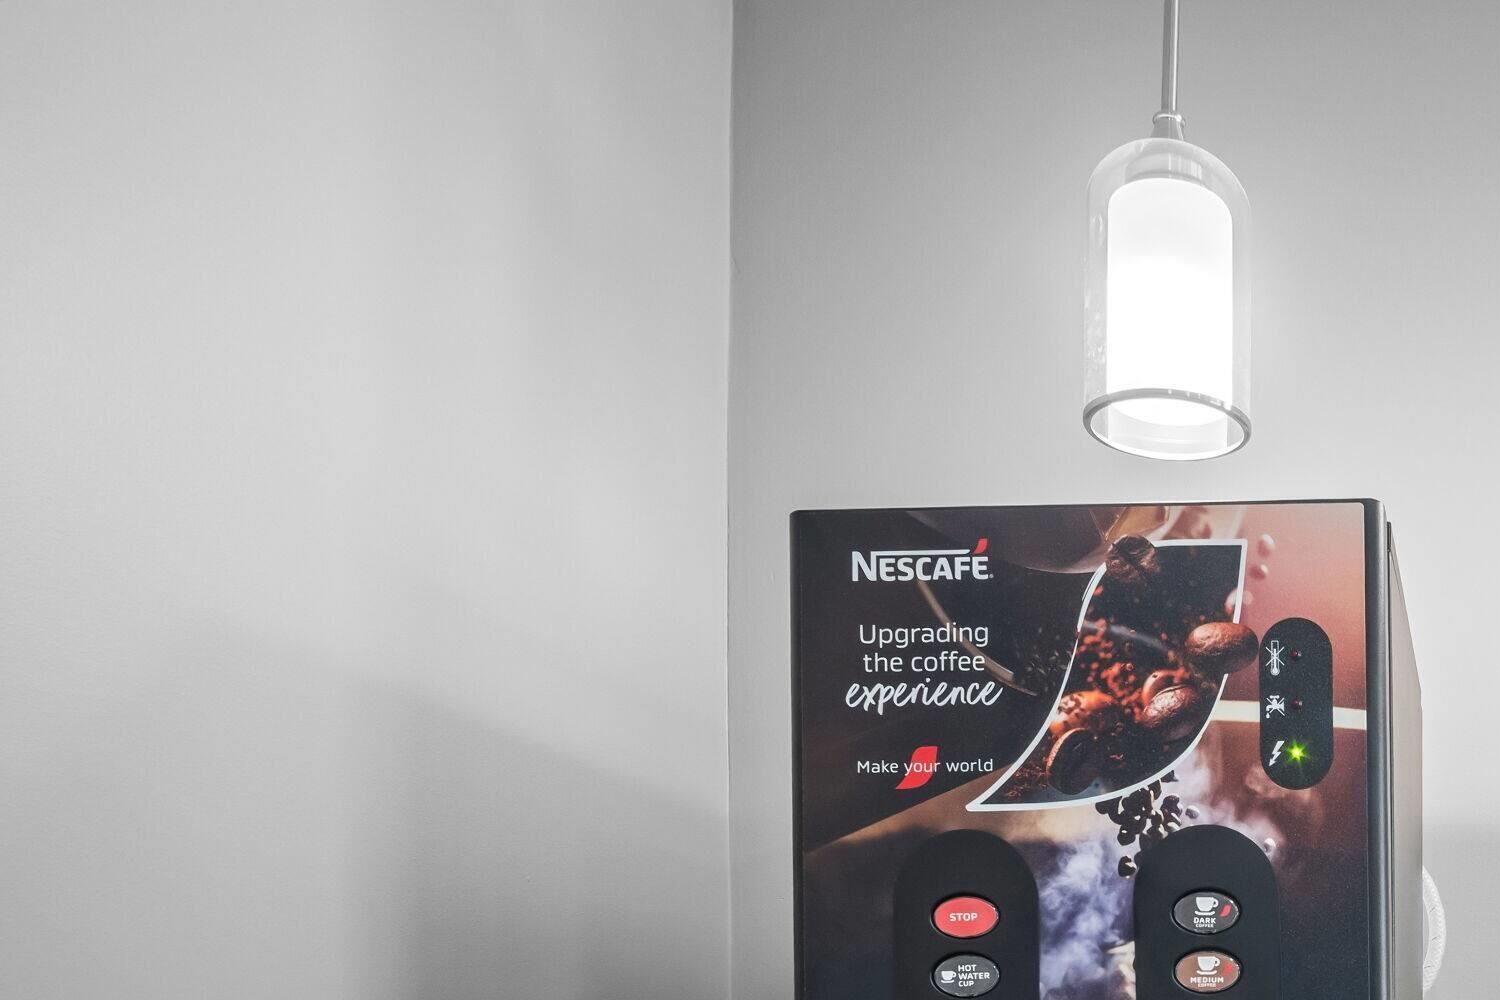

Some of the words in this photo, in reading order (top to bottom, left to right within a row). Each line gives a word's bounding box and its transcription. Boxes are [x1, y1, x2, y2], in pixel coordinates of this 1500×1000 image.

[851, 538, 989, 582] NESCAFÉ
[859, 622, 989, 649] Upgrading
[863, 652, 903, 673] the
[911, 650, 986, 672] coffee
[845, 677, 1004, 716] experience
[857, 760, 899, 774] Make
[904, 762, 941, 776] your
[946, 758, 993, 772] world
[949, 912, 978, 922] STOP
[957, 964, 977, 972] HOT
[957, 972, 990, 980] WATER
